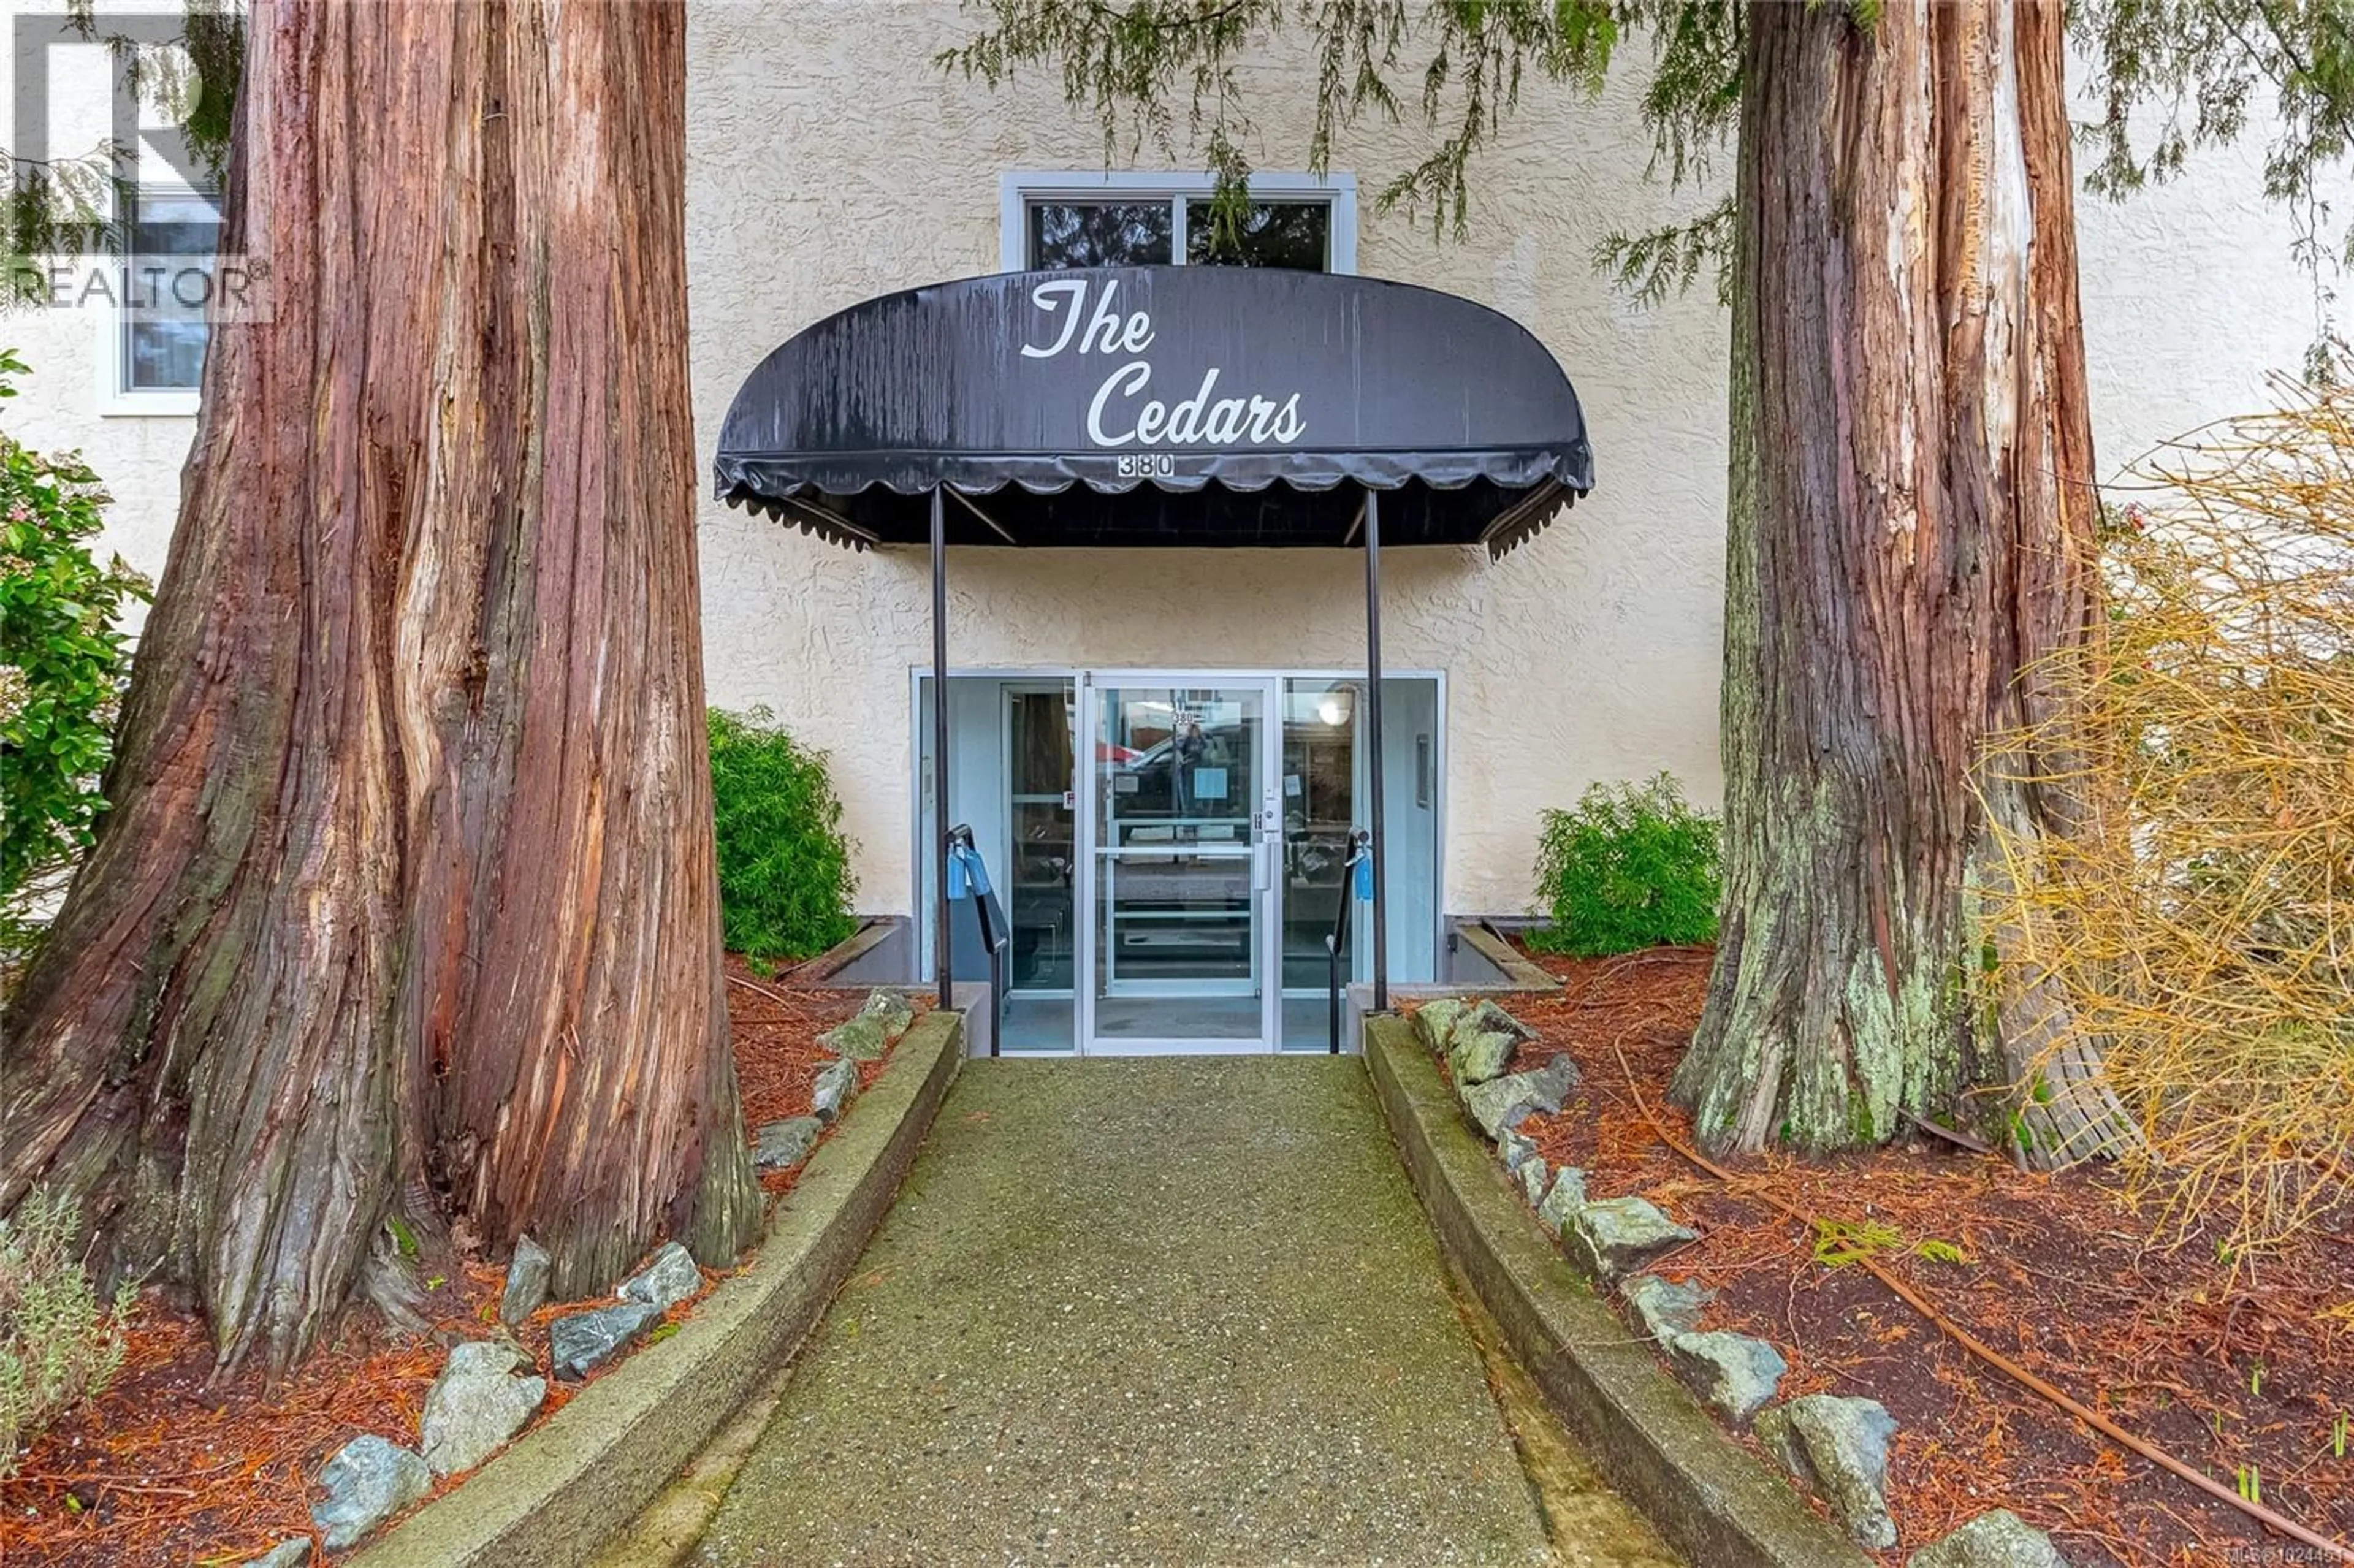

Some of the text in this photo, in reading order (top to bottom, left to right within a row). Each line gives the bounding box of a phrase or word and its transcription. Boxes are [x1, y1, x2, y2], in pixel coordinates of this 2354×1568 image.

[1021, 278, 1156, 359] The
[1086, 360, 1307, 447] Cedars
[1119, 455, 1173, 476] 380
